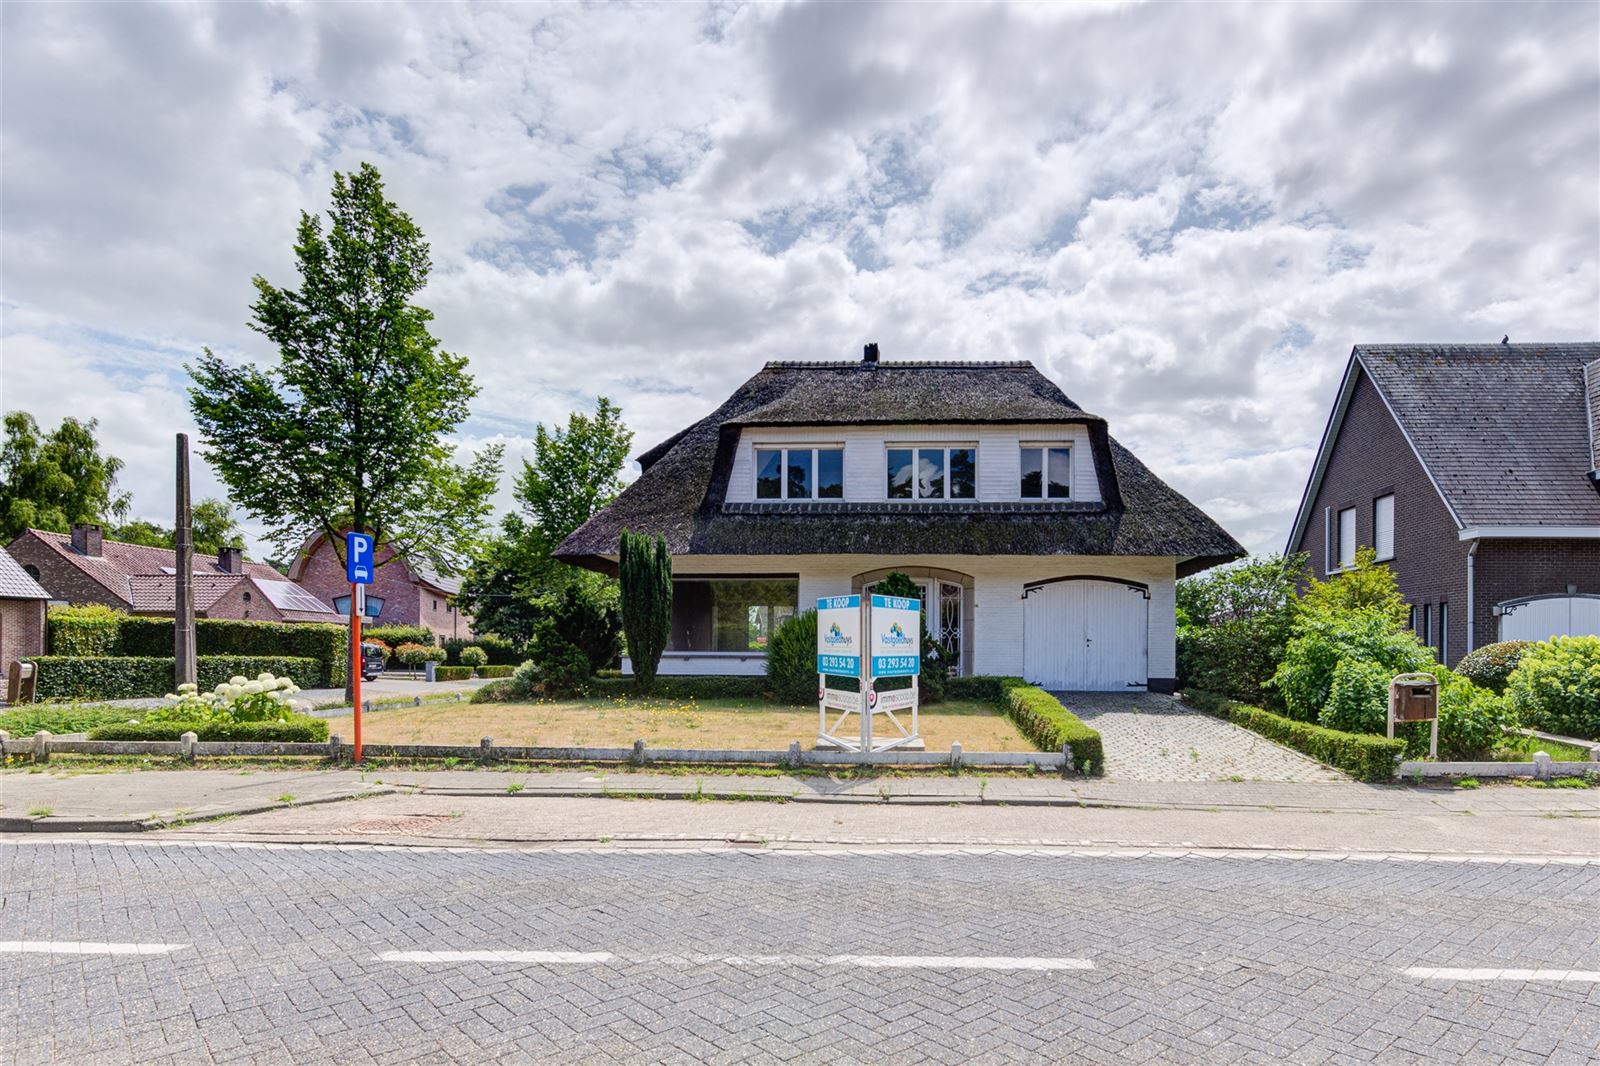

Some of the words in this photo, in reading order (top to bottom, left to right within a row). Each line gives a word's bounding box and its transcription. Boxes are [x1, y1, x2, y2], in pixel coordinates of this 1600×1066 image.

[354, 536, 368, 563] P
[826, 599, 833, 609] TE
[833, 598, 849, 608] KOOP
[884, 597, 892, 608] TE
[893, 599, 909, 609] KOOP
[822, 657, 829, 667] 03
[829, 657, 839, 668] 293
[839, 657, 846, 668] 54
[847, 658, 854, 669] 20
[878, 657, 886, 669] 03
[887, 657, 899, 669] 293
[900, 657, 908, 669] 54
[908, 656, 915, 669] 20
